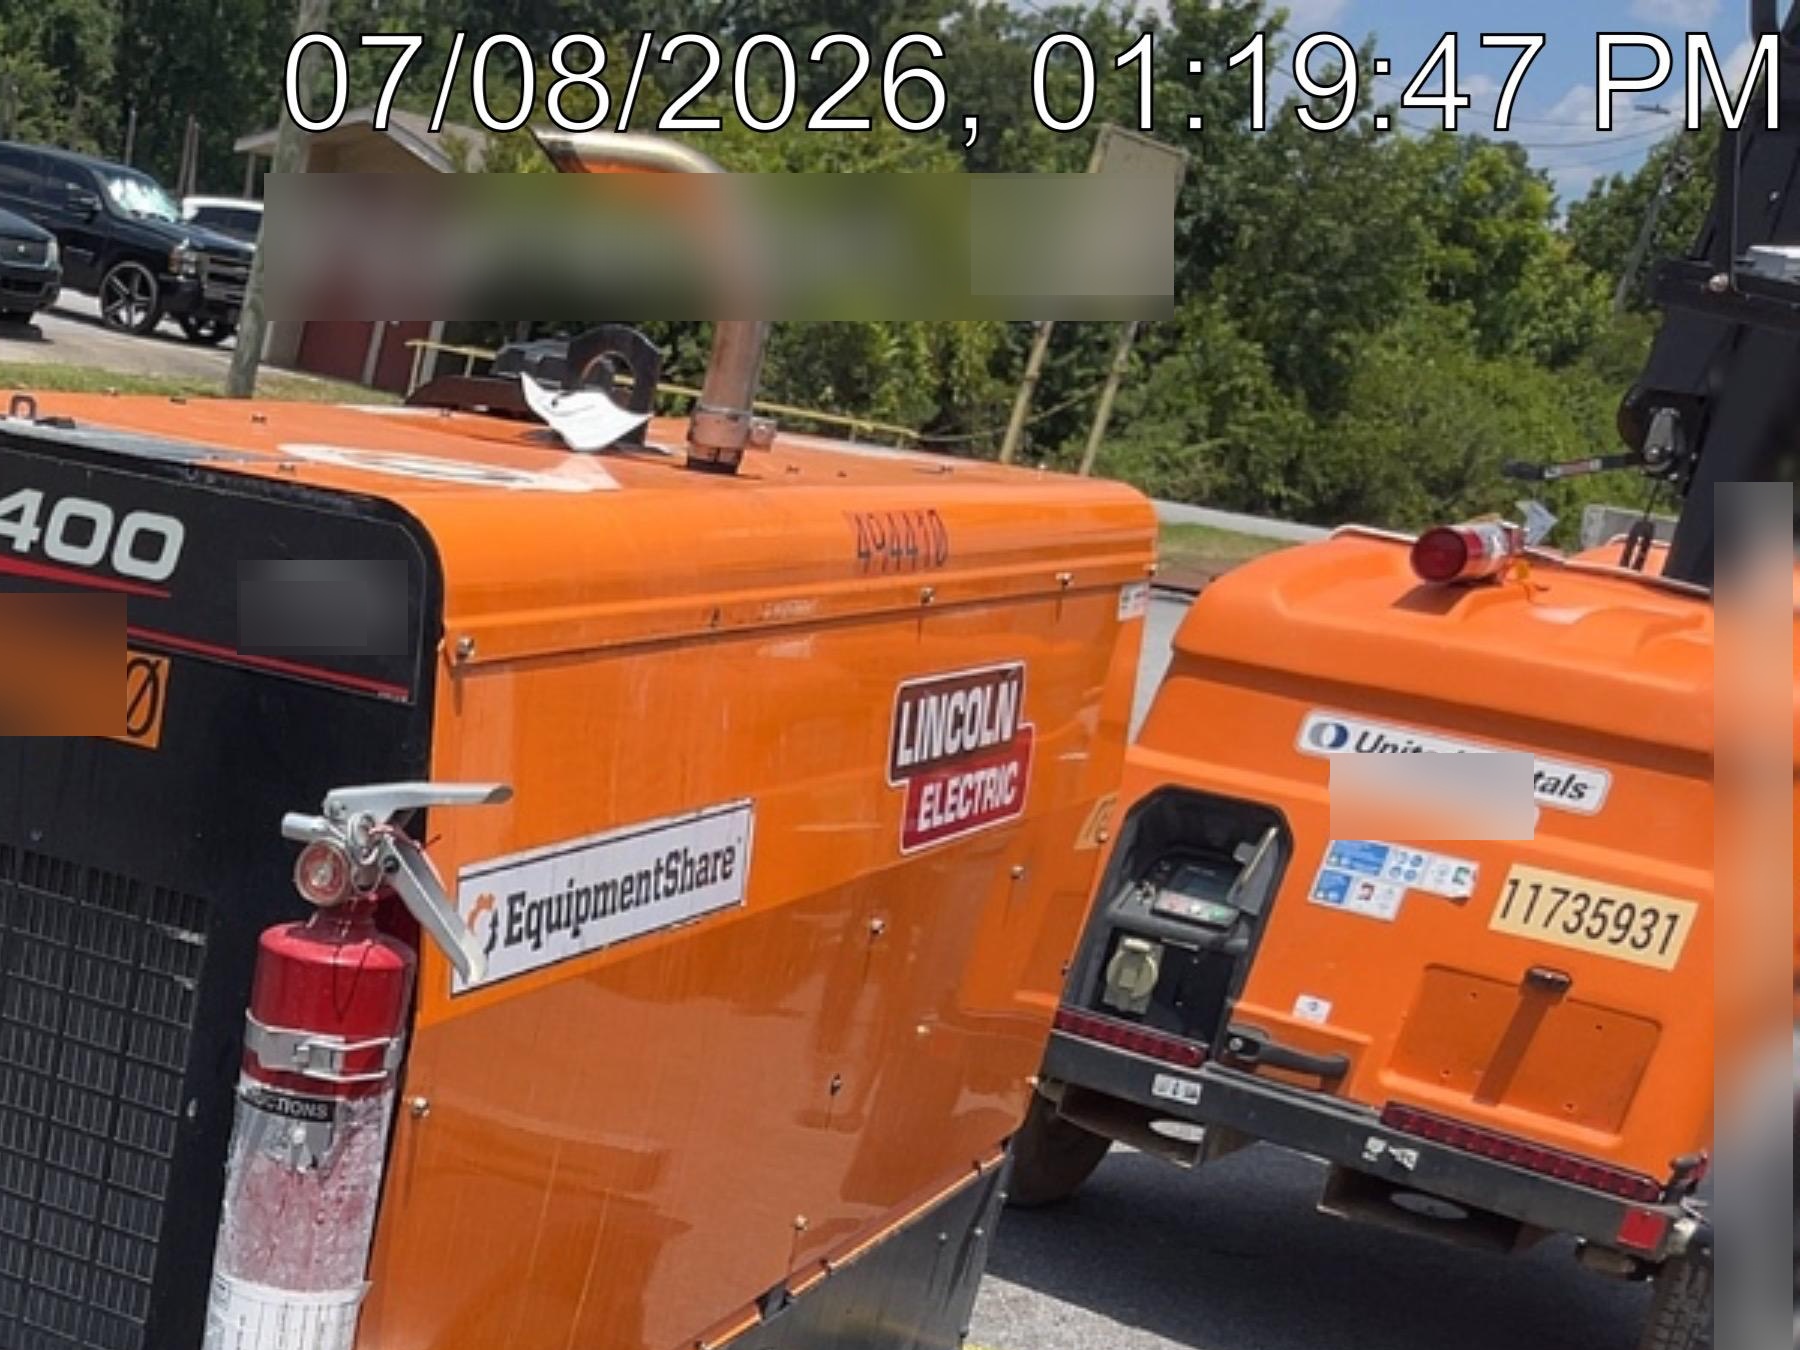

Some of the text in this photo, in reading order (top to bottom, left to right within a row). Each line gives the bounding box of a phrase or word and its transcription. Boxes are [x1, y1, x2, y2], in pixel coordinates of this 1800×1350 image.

[896, 679, 1018, 767] LINCOLN
[917, 760, 1019, 833] ELECTRIC
[503, 845, 737, 952] EquipmentShare
[1499, 877, 1682, 957] 11735931
